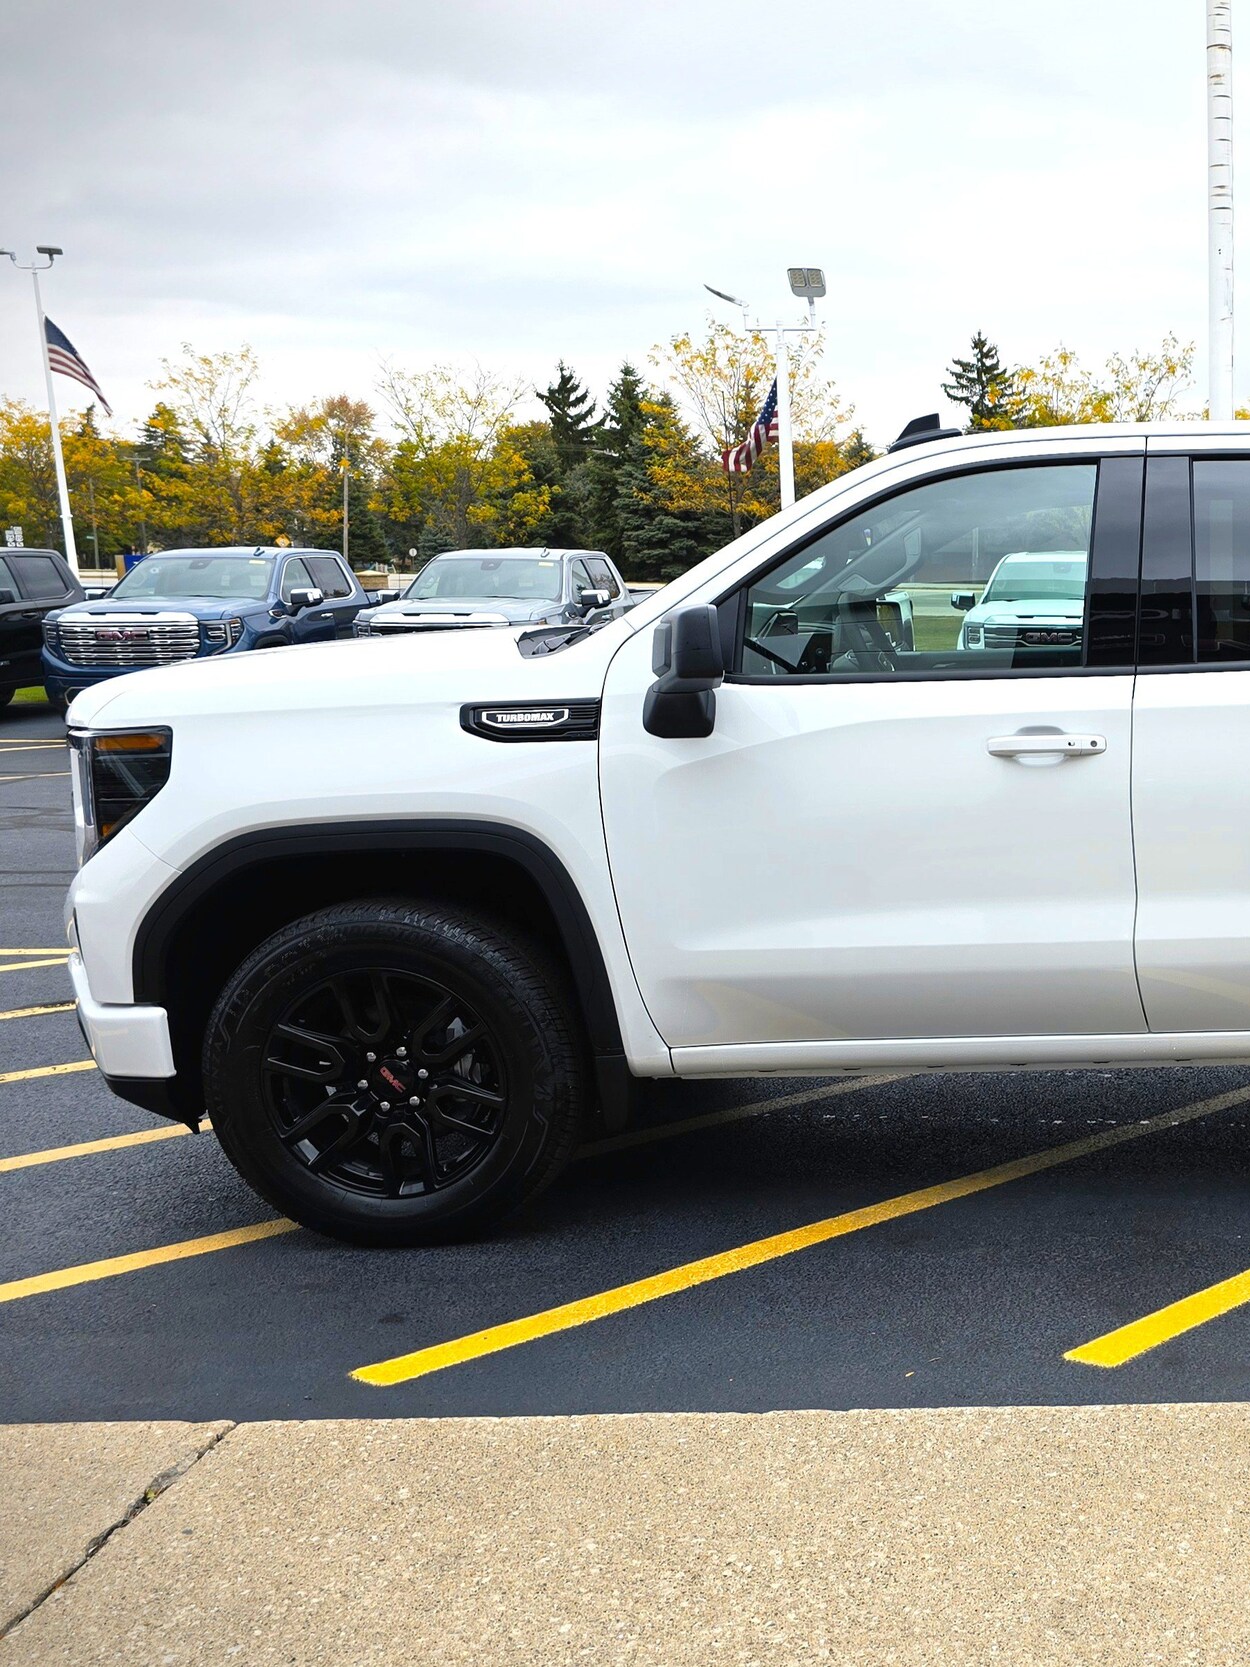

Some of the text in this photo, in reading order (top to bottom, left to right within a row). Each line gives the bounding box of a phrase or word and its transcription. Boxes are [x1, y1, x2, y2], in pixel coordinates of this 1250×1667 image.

[96, 630, 147, 640] GMC
[1025, 632, 1073, 642] GMC
[496, 712, 554, 723] TURBOMAX
[380, 1066, 406, 1093] GMC
